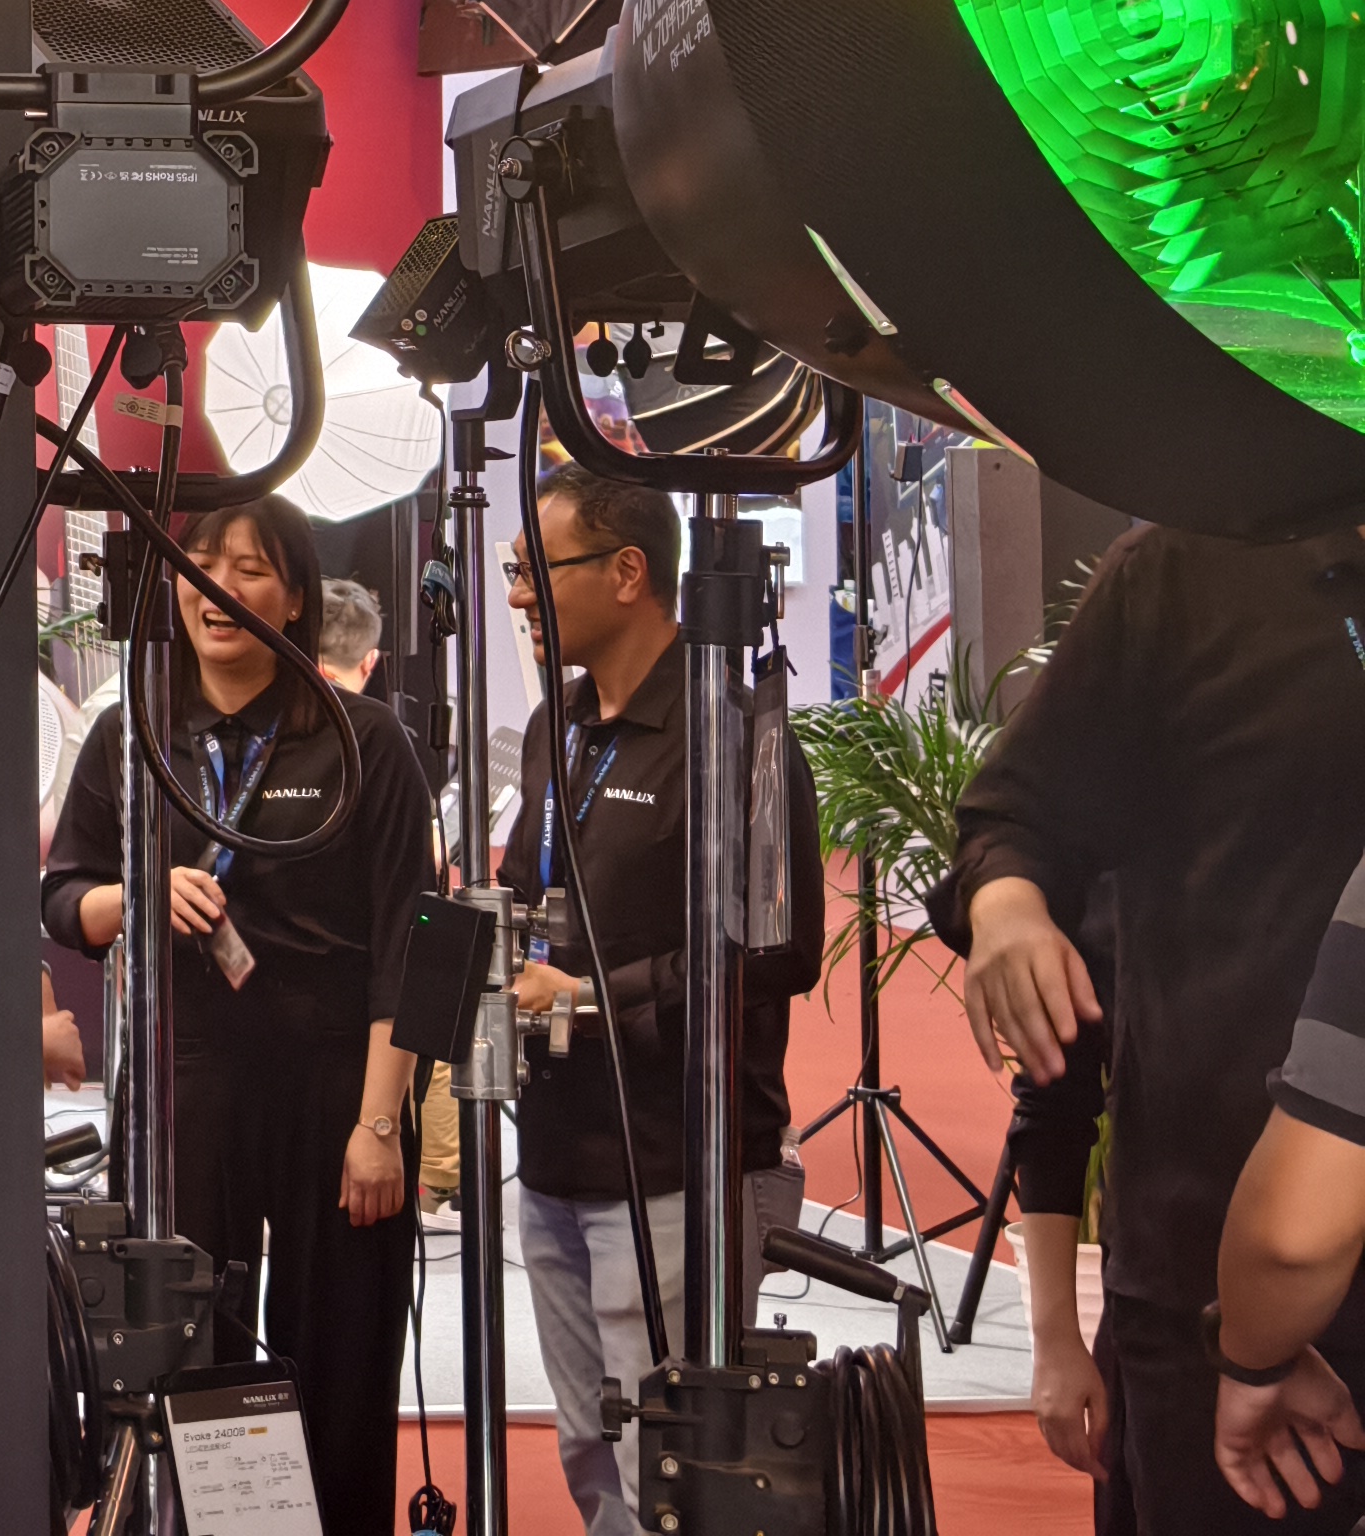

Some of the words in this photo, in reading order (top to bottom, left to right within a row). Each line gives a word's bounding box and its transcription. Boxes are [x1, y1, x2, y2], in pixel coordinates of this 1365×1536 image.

[197, 109, 248, 123] NLUX
[145, 172, 175, 182] RoHS
[176, 173, 198, 182] IP55
[481, 138, 500, 237] NANLUX
[262, 787, 322, 799] NANLUX
[604, 787, 656, 805] NANLUX
[543, 811, 554, 847] BIRTV
[242, 1394, 277, 1404] NANLUX
[184, 1432, 211, 1442] Evoke
